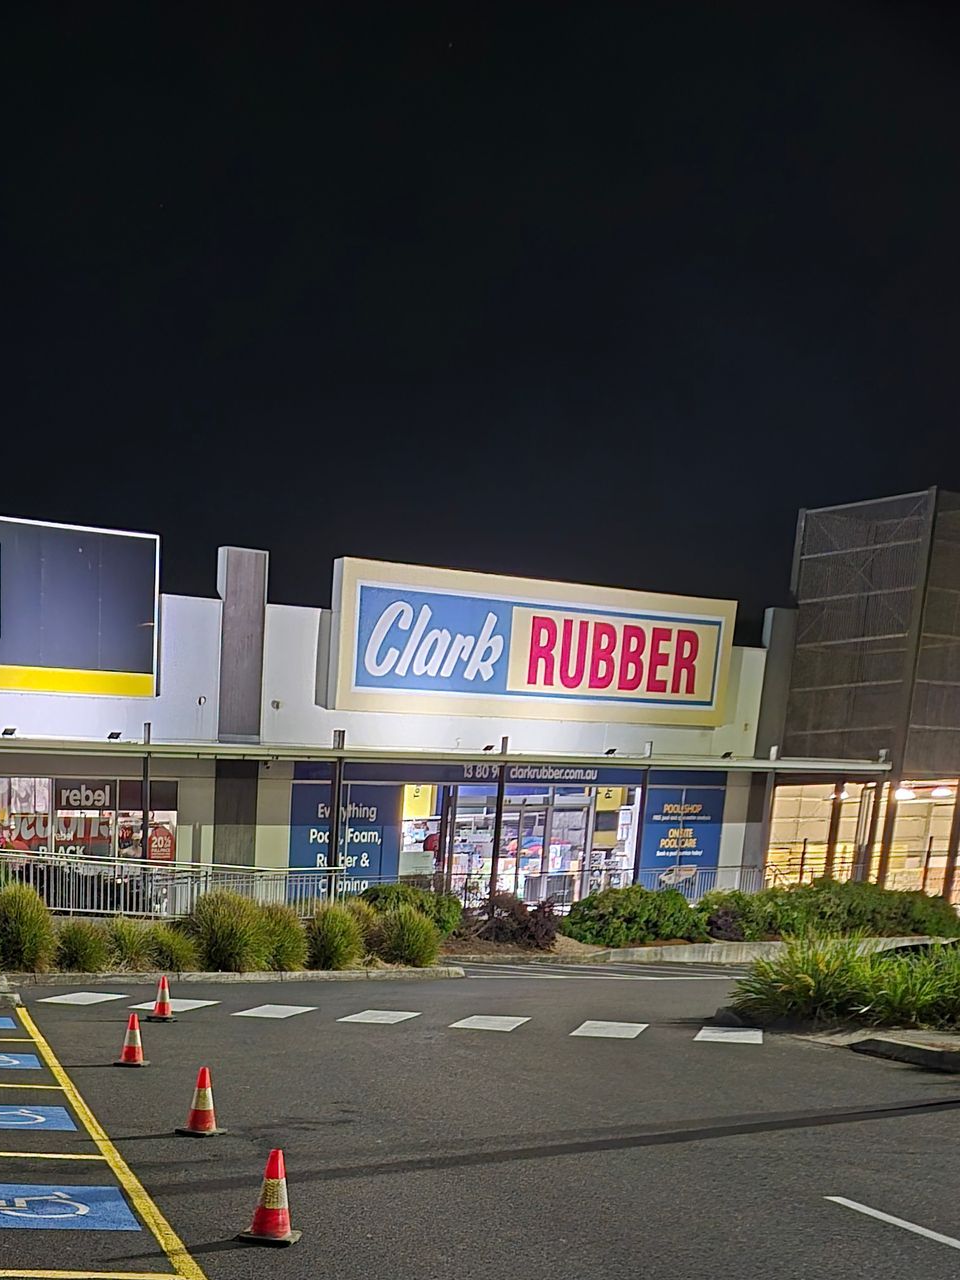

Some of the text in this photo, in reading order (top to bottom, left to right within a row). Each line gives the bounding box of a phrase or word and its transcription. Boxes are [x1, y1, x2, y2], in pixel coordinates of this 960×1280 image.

[364, 600, 699, 695] Clark RUBBER
[491, 766, 499, 779] 9
[510, 766, 598, 780] clarkrubber.com.au
[61, 784, 111, 807] rebel
[318, 803, 377, 821] Evything
[347, 827, 382, 845] Foam,
[39, 845, 85, 859] BACK
[317, 852, 370, 868] Rber &
